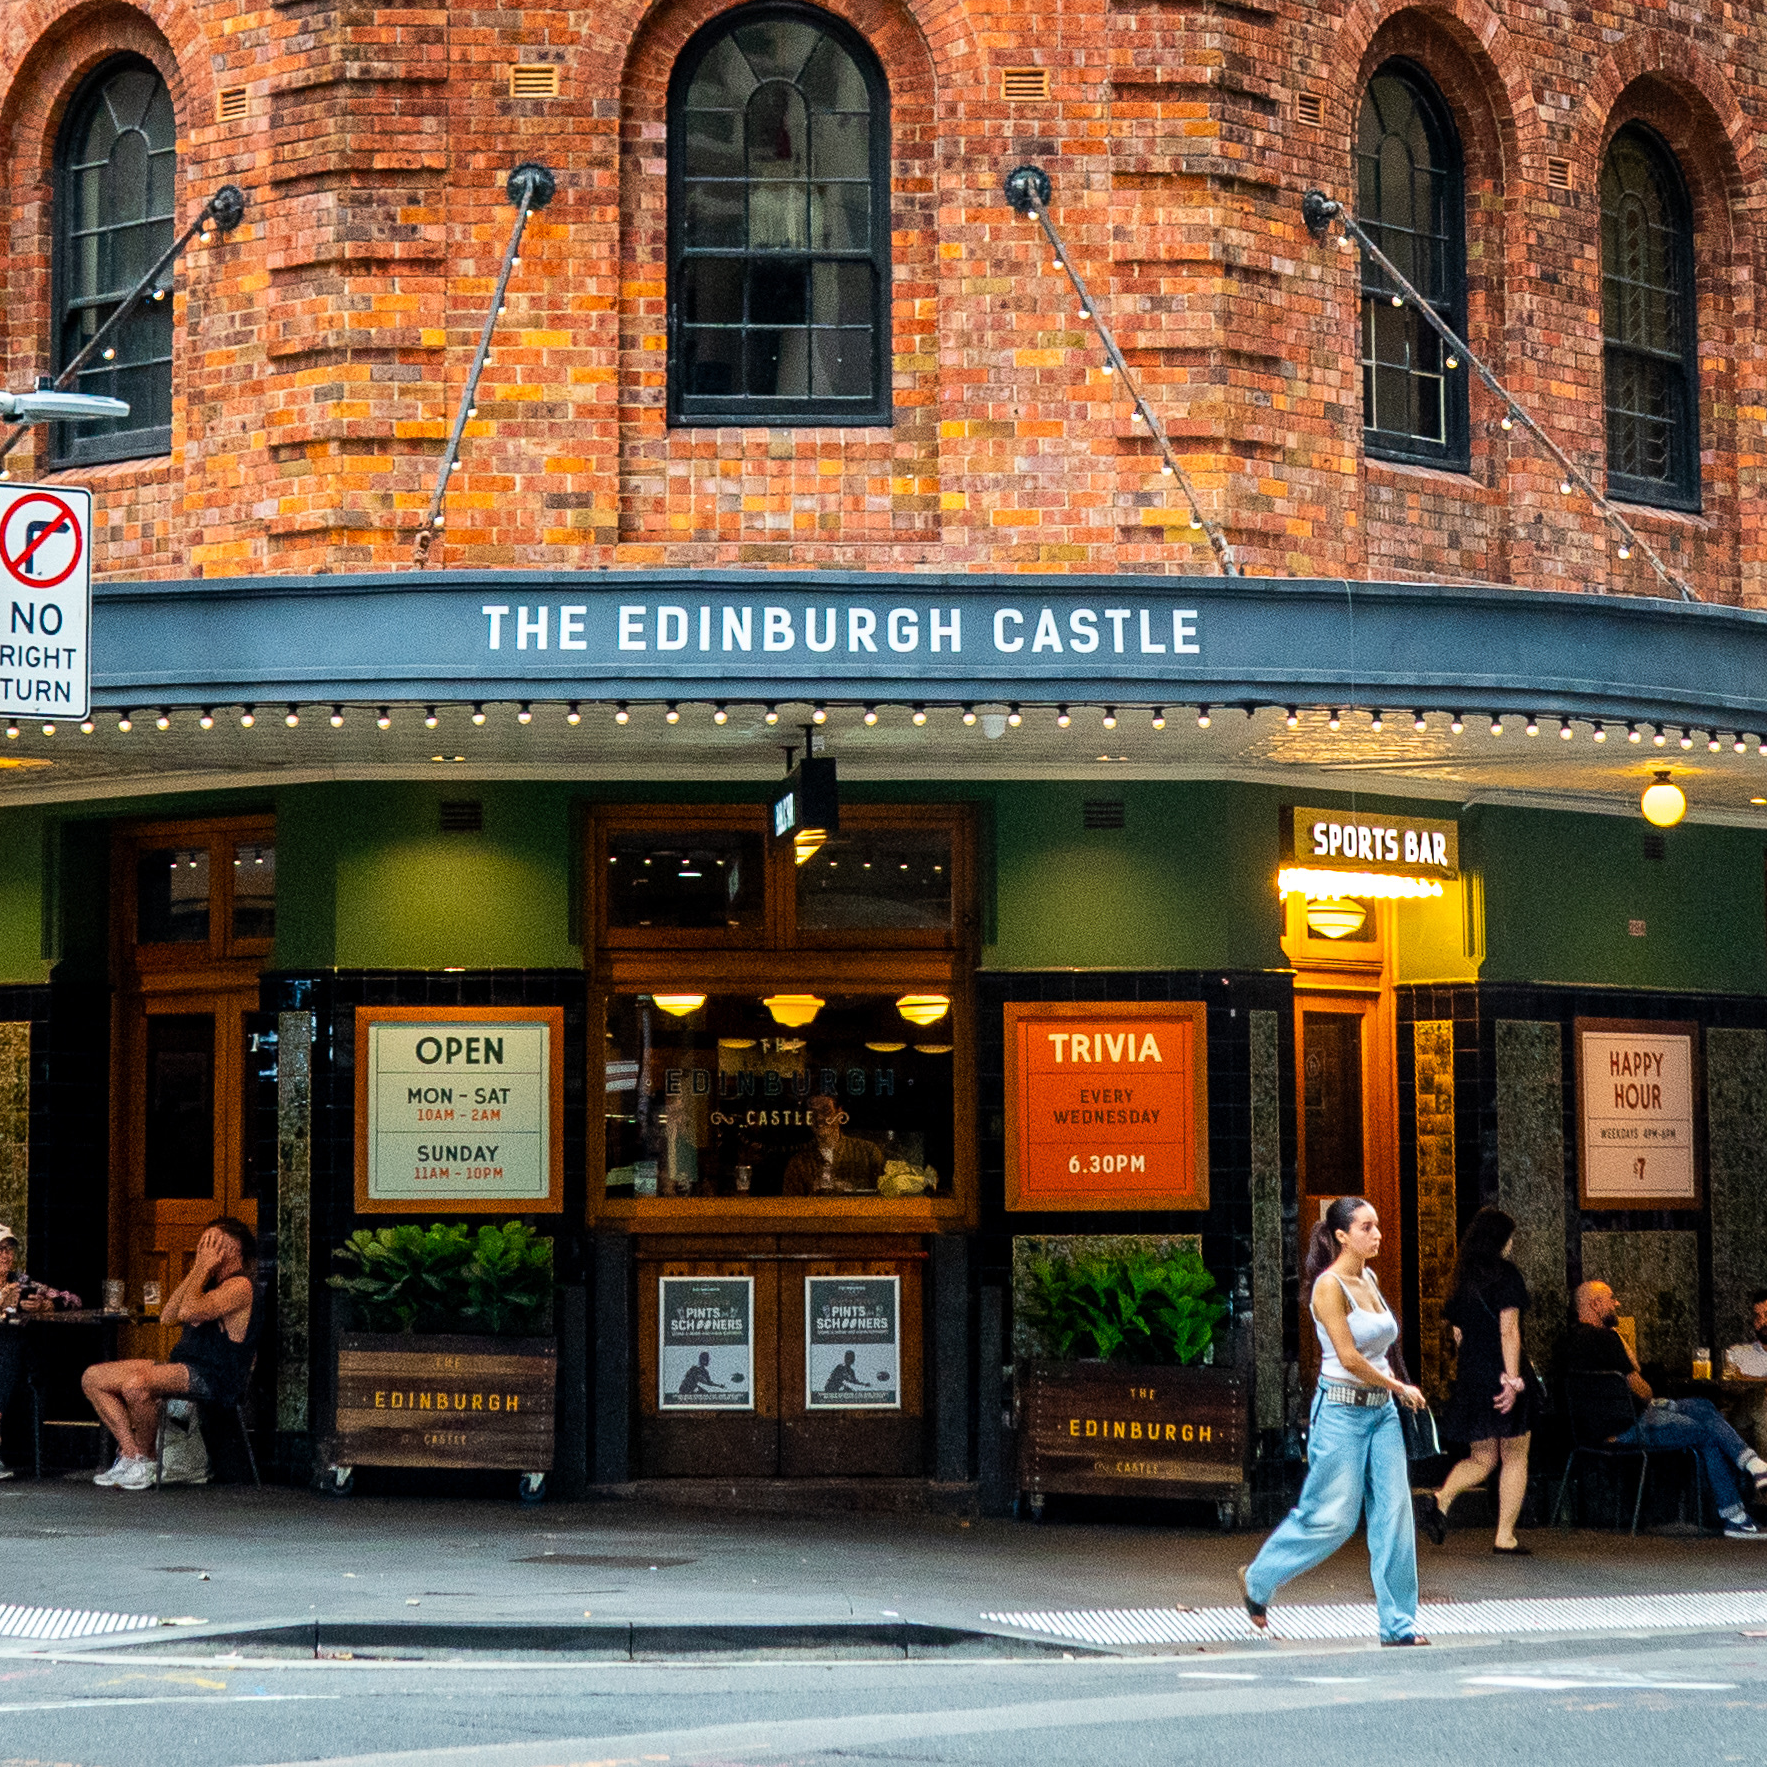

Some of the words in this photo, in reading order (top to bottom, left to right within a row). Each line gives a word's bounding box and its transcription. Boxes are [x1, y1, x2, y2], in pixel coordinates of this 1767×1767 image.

[11, 601, 63, 636] NO
[482, 604, 587, 652] THE
[618, 605, 961, 654] EDINBURGH
[992, 607, 1201, 655] CASTLE
[0, 644, 76, 669] RIGHT
[0, 678, 71, 702] TURN
[1313, 822, 1399, 861] SPORTS
[1404, 830, 1448, 867] BAR
[415, 1036, 504, 1065] OPEN
[760, 1038, 800, 1054] THE
[1048, 1033, 1163, 1063] TRIVIA
[1610, 1050, 1664, 1077] HAPPY
[665, 1068, 895, 1096] EDINBURGH
[407, 1088, 453, 1104] MON
[474, 1088, 511, 1104] SAT
[1080, 1089, 1134, 1104] EVERY
[1614, 1083, 1662, 1110] HOUR
[417, 1109, 454, 1121] 10AM
[471, 1109, 501, 1121] 2AM
[747, 1110, 813, 1126] CASTLE
[1053, 1109, 1160, 1124] WEDNESDAY
[1600, 1128, 1638, 1140] WEEKDAYS
[417, 1145, 499, 1162] SUNDAY
[1068, 1154, 1146, 1173] 6.30PM
[413, 1167, 450, 1180] 11AM
[466, 1167, 504, 1180] 10PM
[686, 1307, 721, 1319] PINTS
[832, 1306, 866, 1317] PINTS
[375, 1391, 520, 1412] EDINBURGH
[1130, 1388, 1155, 1400] THE
[1069, 1419, 1212, 1442] EDINBURGH
